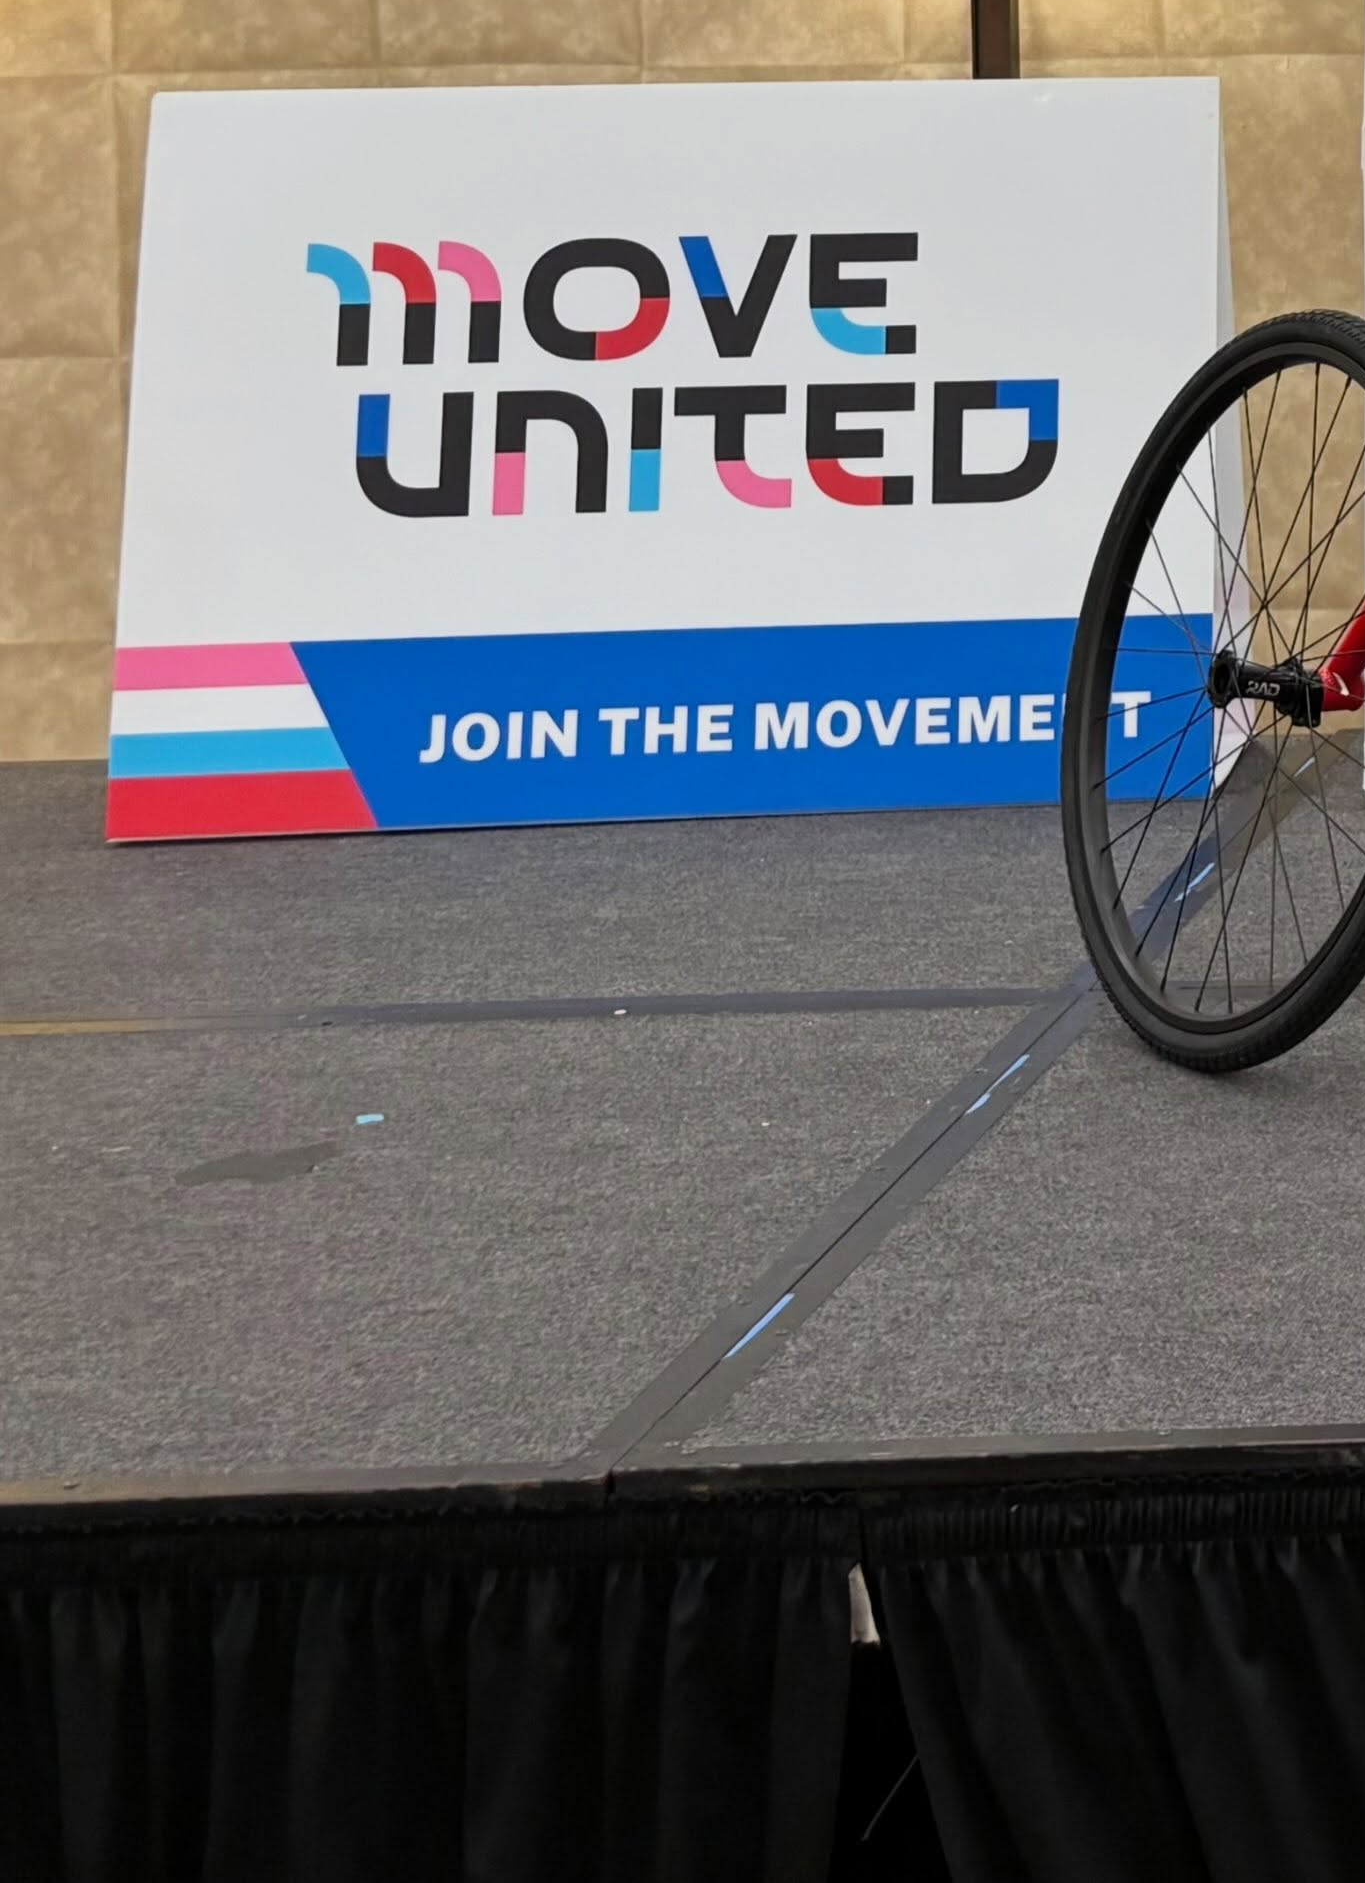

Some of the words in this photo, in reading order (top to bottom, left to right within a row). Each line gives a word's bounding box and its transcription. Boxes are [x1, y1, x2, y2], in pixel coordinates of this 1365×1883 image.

[306, 232, 919, 366] MOVE
[355, 378, 1060, 519] UNITED
[419, 709, 579, 765] JOIN
[599, 703, 735, 756] THE
[755, 691, 1152, 751] MOVEMET
